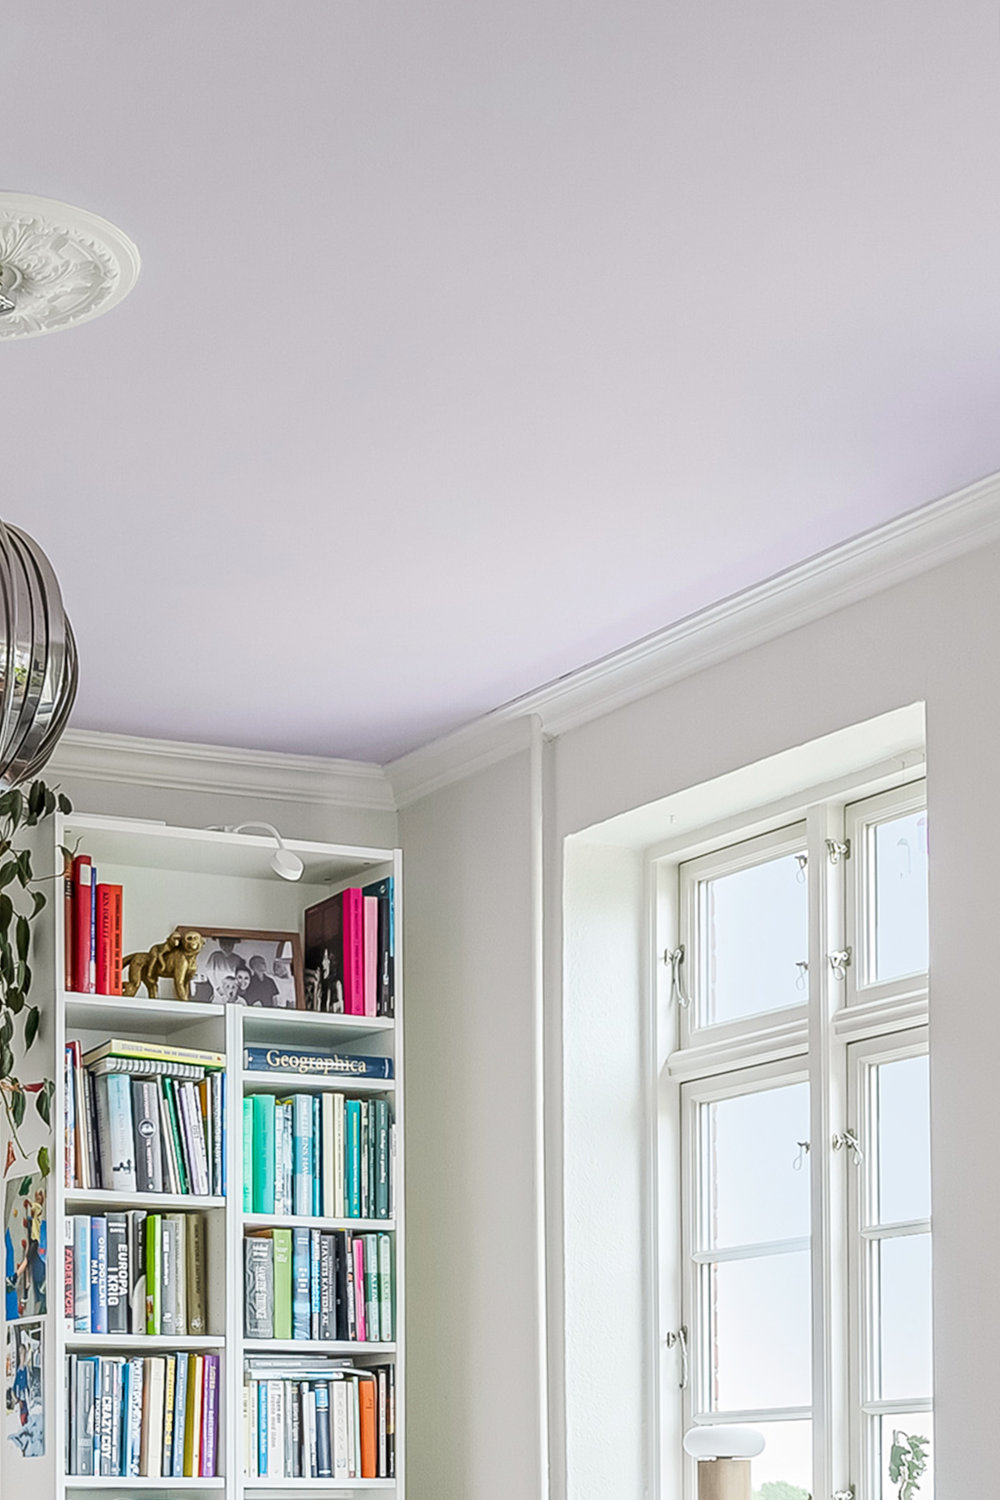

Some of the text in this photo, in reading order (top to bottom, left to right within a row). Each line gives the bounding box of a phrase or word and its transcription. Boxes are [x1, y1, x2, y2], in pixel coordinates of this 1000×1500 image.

[266, 1049, 367, 1075] Geographica
[65, 1248, 73, 1315] FADER VOR
[118, 1243, 128, 1297] EUROPA
[108, 1274, 119, 1306] KRIG
[101, 1396, 112, 1435] CRAZY
